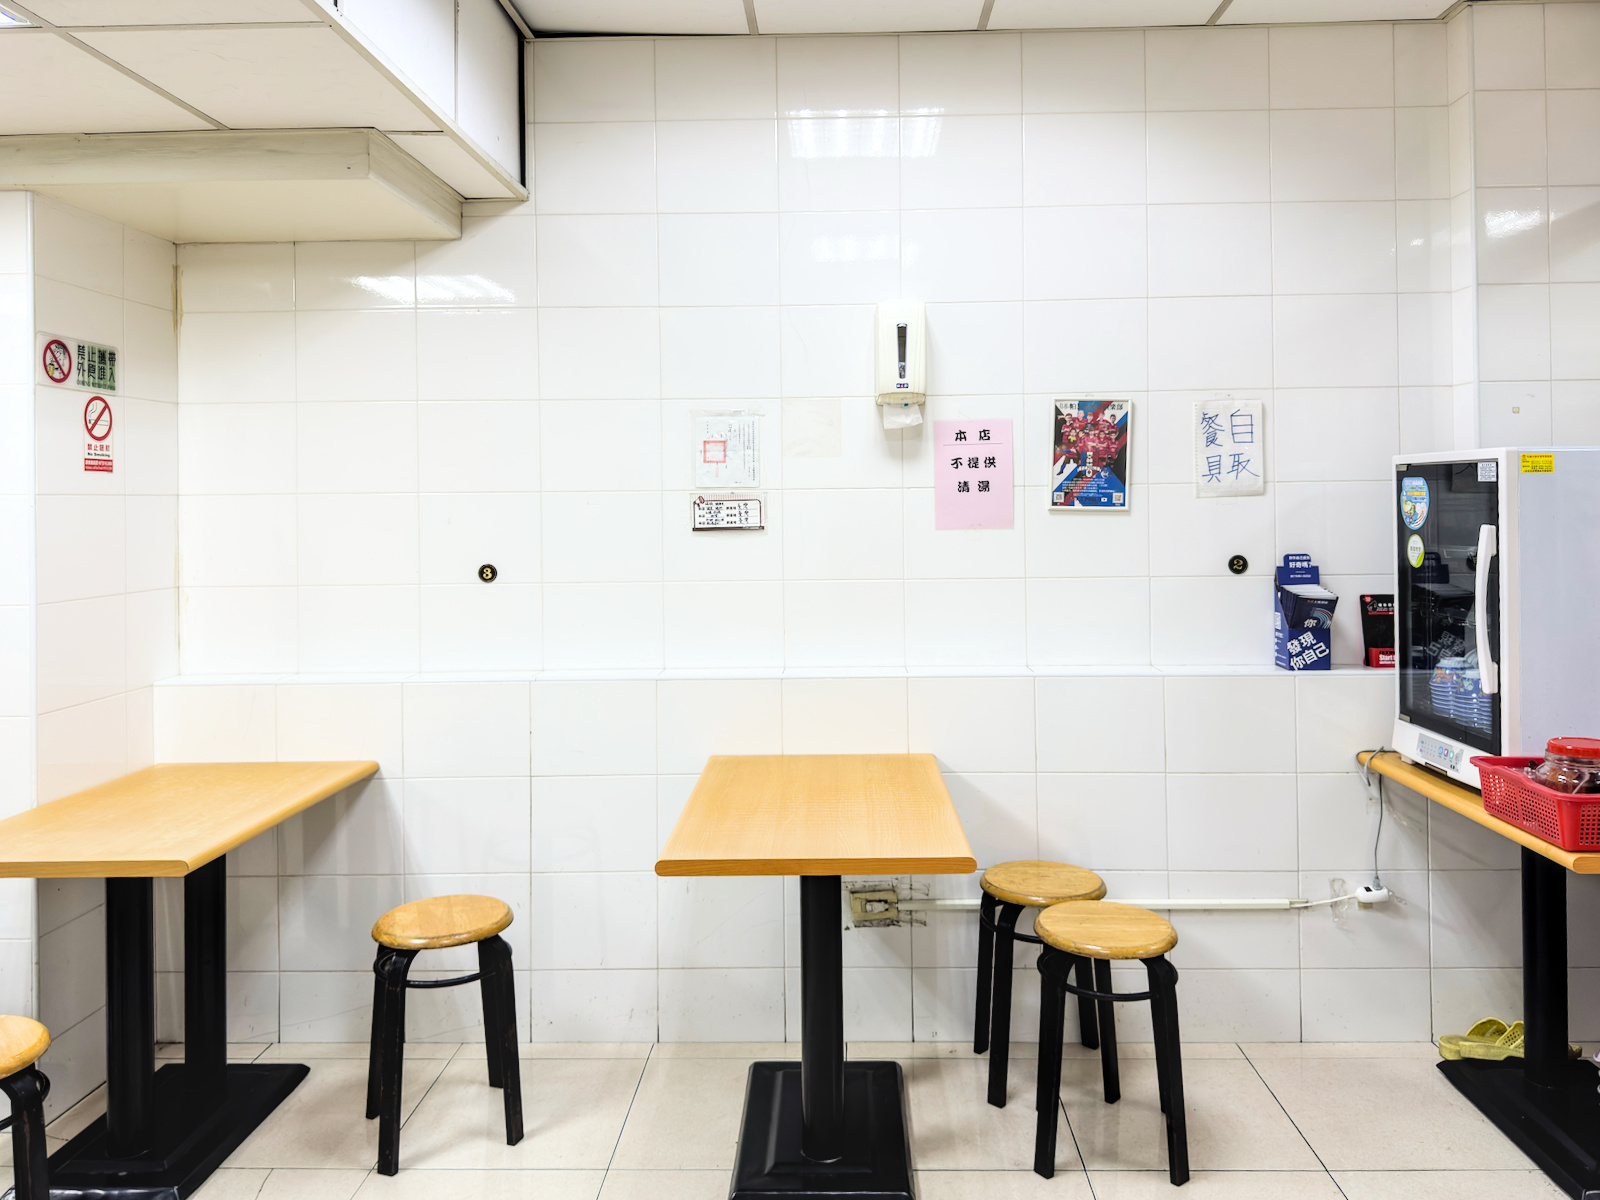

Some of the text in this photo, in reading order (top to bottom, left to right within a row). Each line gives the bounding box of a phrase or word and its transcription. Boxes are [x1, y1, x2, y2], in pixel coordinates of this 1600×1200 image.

[77, 344, 116, 367] 禁止攜帶
[955, 429, 991, 442] 本店
[950, 456, 997, 470] 不提供
[1233, 558, 1244, 570] 2
[482, 567, 493, 580] 3
[1286, 631, 1317, 656] 發現
[1290, 642, 1330, 671] 你自己
